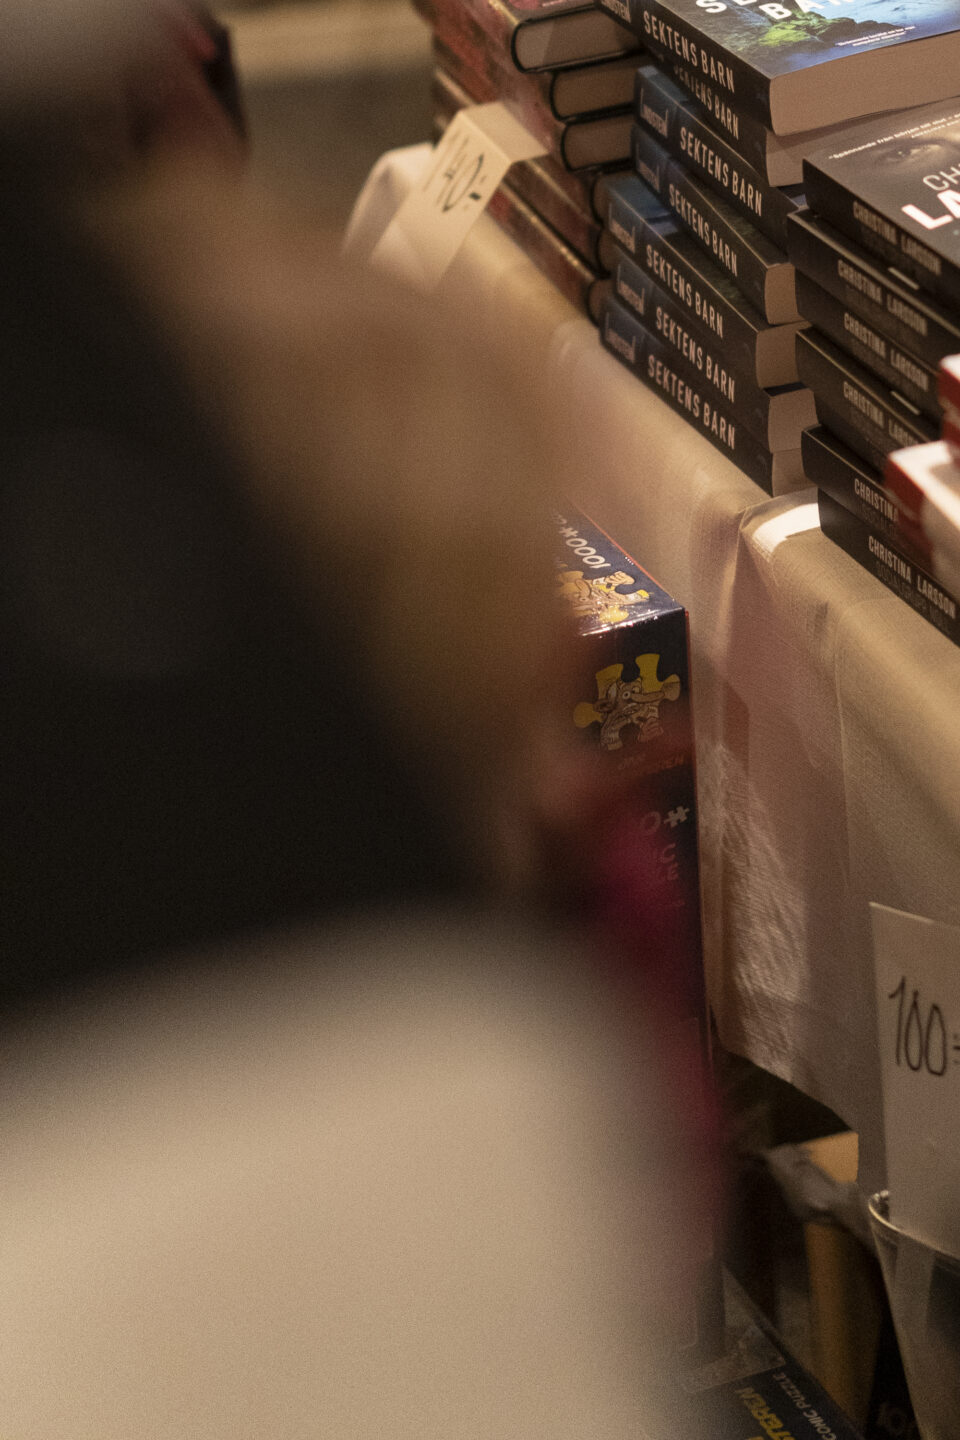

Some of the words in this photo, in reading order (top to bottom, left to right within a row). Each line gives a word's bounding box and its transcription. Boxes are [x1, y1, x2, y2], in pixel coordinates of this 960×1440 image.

[643, 10, 698, 67] SEKTENS
[701, 48, 735, 93] BARN
[714, 94, 739, 140] BARN
[680, 126, 729, 188] SEKTENS
[732, 170, 763, 217] BARN
[668, 183, 711, 247] SEKTENS
[712, 229, 738, 277] BARN
[646, 244, 693, 307] SEKTENS
[695, 292, 724, 339] BARN
[656, 306, 704, 371] SEKTENS
[706, 355, 735, 404] BARN
[844, 312, 886, 358] CHRISTINA
[648, 354, 700, 418] SEKTENS
[703, 403, 736, 451] BARN
[843, 381, 884, 429] CHRISTINA
[854, 478, 899, 522] CHRISTINA
[565, 537, 612, 569] 1000
[868, 535, 912, 584] CHRISTINA
[917, 573, 956, 619] LARSSON
